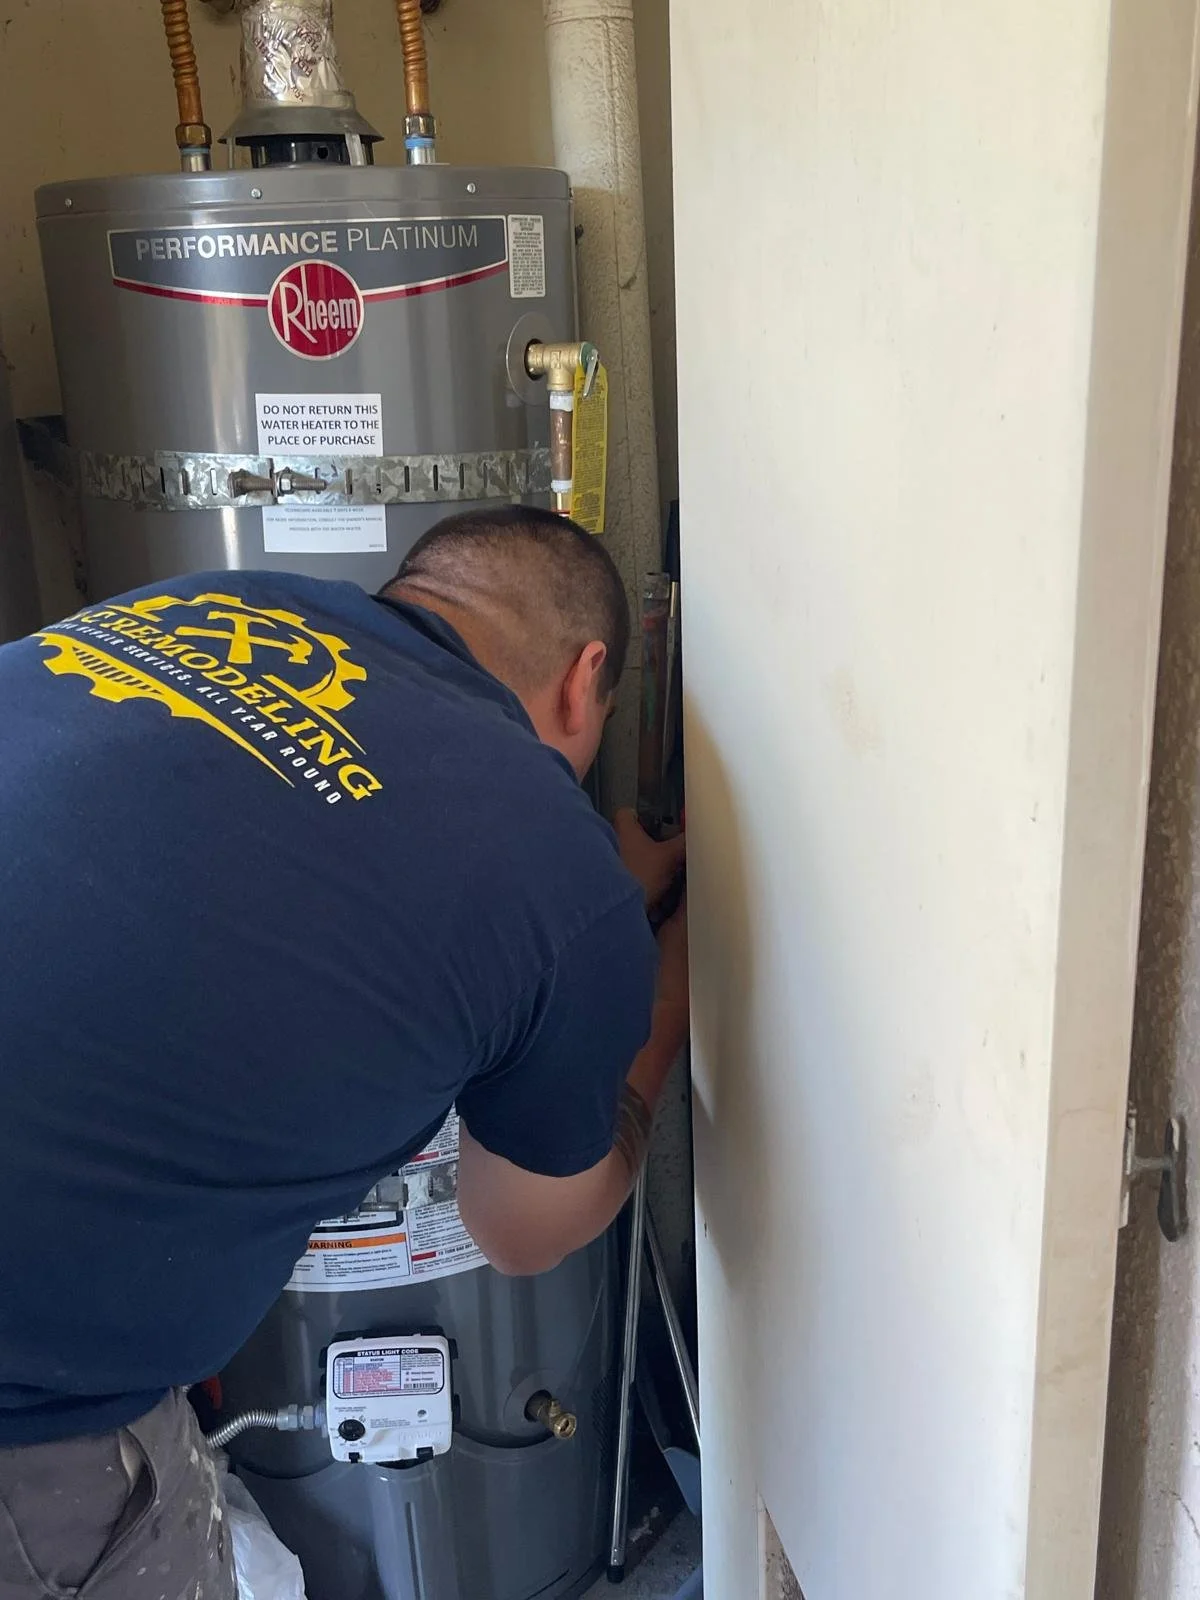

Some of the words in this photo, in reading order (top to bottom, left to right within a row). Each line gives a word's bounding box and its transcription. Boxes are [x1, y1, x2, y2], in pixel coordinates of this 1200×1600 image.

[135, 230, 338, 261] PERFORMANCE
[347, 224, 478, 251] PLATINUM
[279, 265, 359, 343] Rheem
[261, 420, 299, 430] WATER
[301, 420, 341, 430] HEATER
[344, 420, 358, 429] TO
[360, 420, 380, 429] THE
[263, 405, 280, 415] DO
[283, 405, 306, 415] NOT
[309, 405, 352, 415] RETURN
[354, 404, 378, 415] THIS
[268, 436, 299, 445] PLACE
[303, 436, 317, 445] OF
[320, 435, 376, 445] PURCHASE
[99, 616, 383, 801] REMODELING
[196, 686, 229, 705] ALL
[230, 706, 278, 741] YEAR
[280, 746, 342, 804] ROUND
